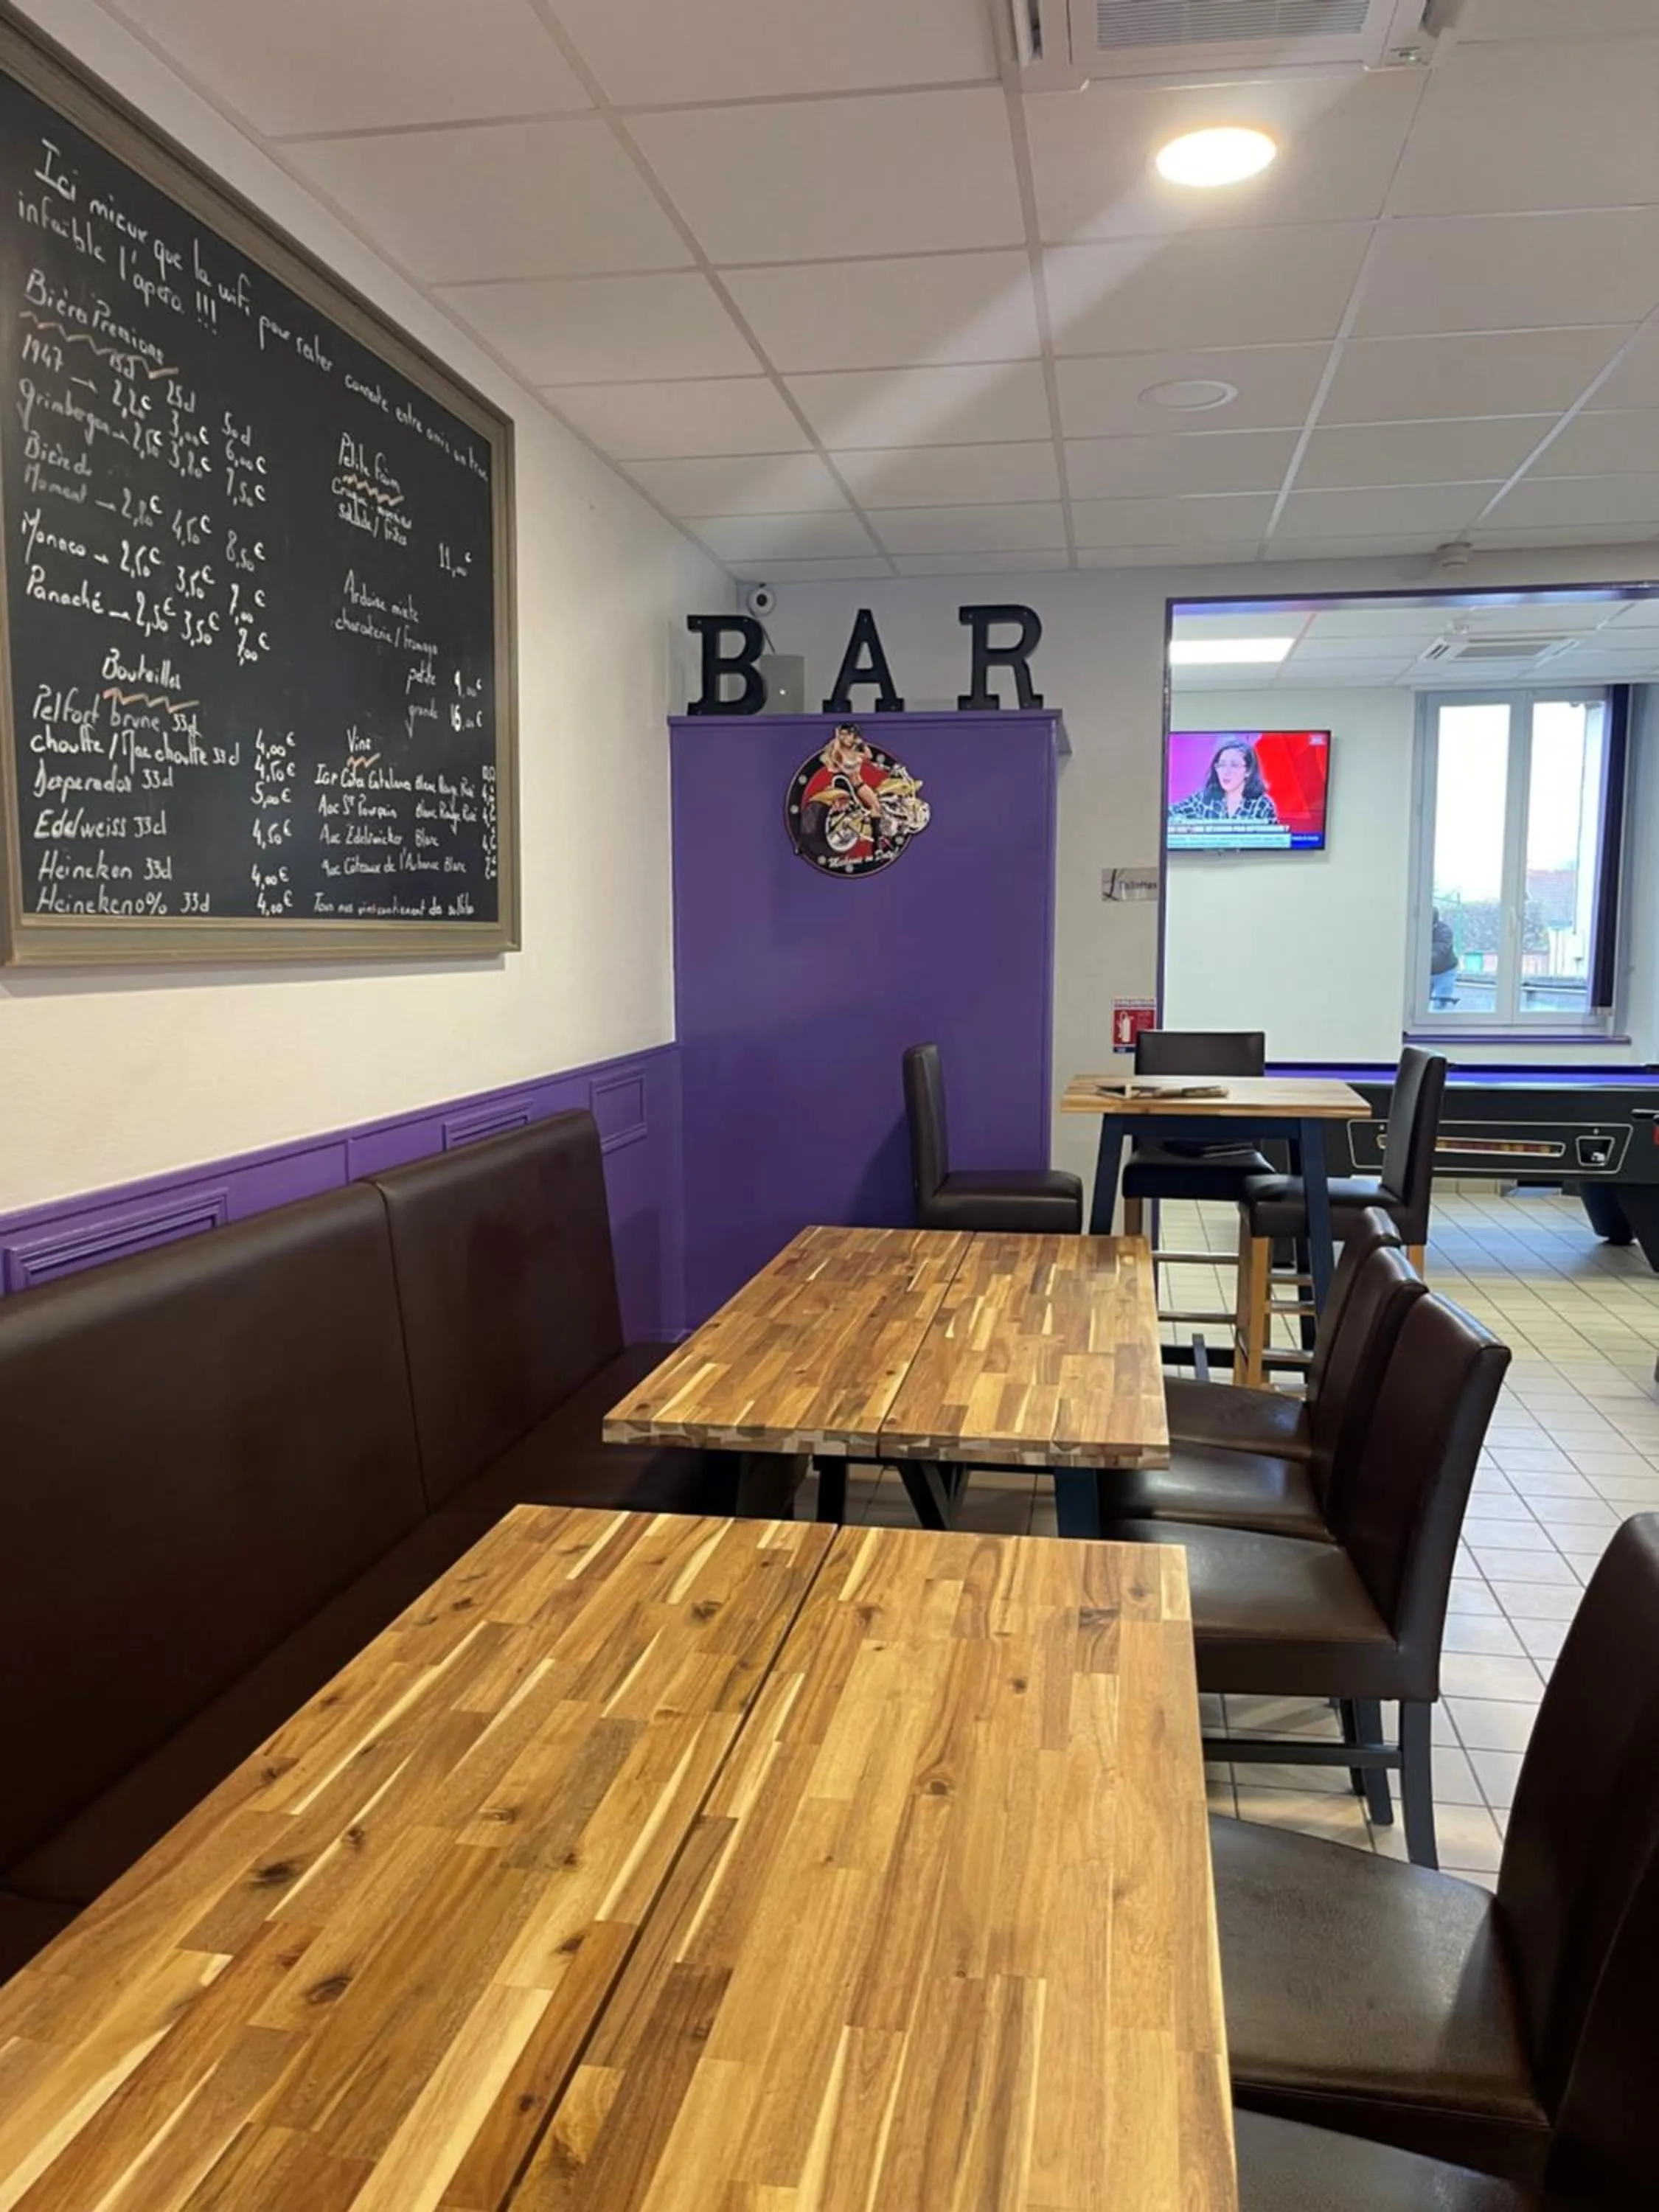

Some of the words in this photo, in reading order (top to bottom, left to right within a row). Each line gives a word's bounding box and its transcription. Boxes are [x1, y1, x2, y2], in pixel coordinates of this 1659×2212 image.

[35, 137, 78, 203] Ici
[88, 193, 149, 245] mieux
[153, 239, 184, 282] que
[193, 237, 212, 288] la
[258, 314, 291, 351] pour
[395, 402, 423, 434] entre
[21, 333, 65, 372] 1947
[20, 507, 87, 565] Monaco
[25, 563, 105, 614] Panaché
[101, 647, 183, 692] Bouteilles
[686, 604, 1044, 717] BAR
[33, 807, 128, 840] Edelweiss
[38, 849, 133, 883] Heineken
